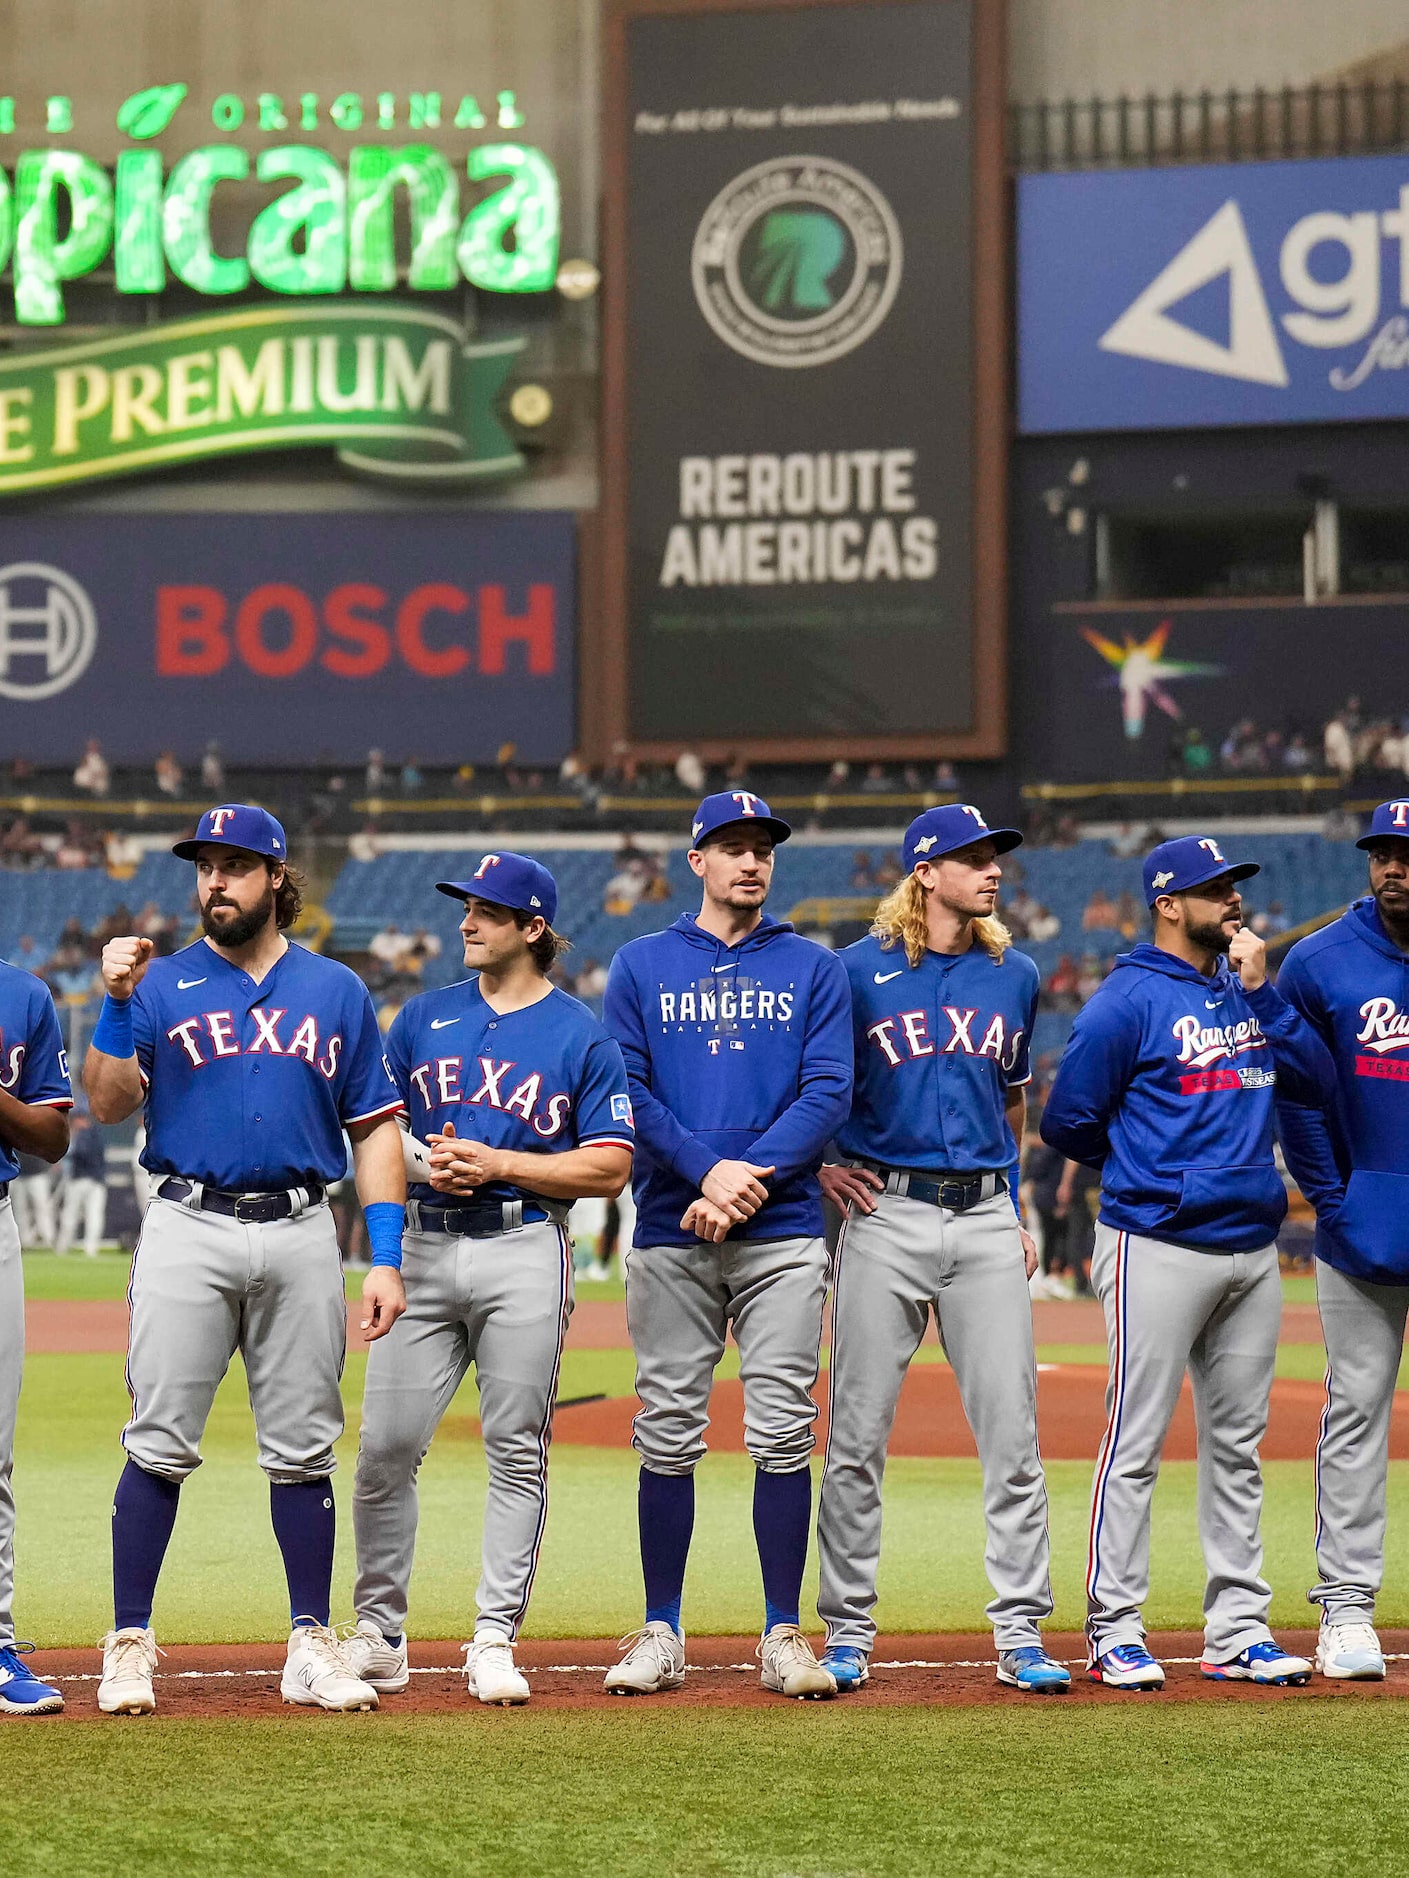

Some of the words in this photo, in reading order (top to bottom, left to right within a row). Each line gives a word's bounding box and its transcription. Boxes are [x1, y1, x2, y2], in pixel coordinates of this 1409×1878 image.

[212, 89, 526, 133] ORIGINAL
[52, 335, 454, 455] PREMIUM
[679, 450, 917, 517] REROUTE
[659, 516, 939, 588] AMERICAS
[156, 583, 555, 678] BOSCH
[659, 980, 794, 990] TEXAS
[660, 989, 794, 1022] RANGERS
[166, 1008, 342, 1080] TEXAS
[866, 1006, 1023, 1072] TEXAS
[409, 1055, 571, 1139] TEXAS
